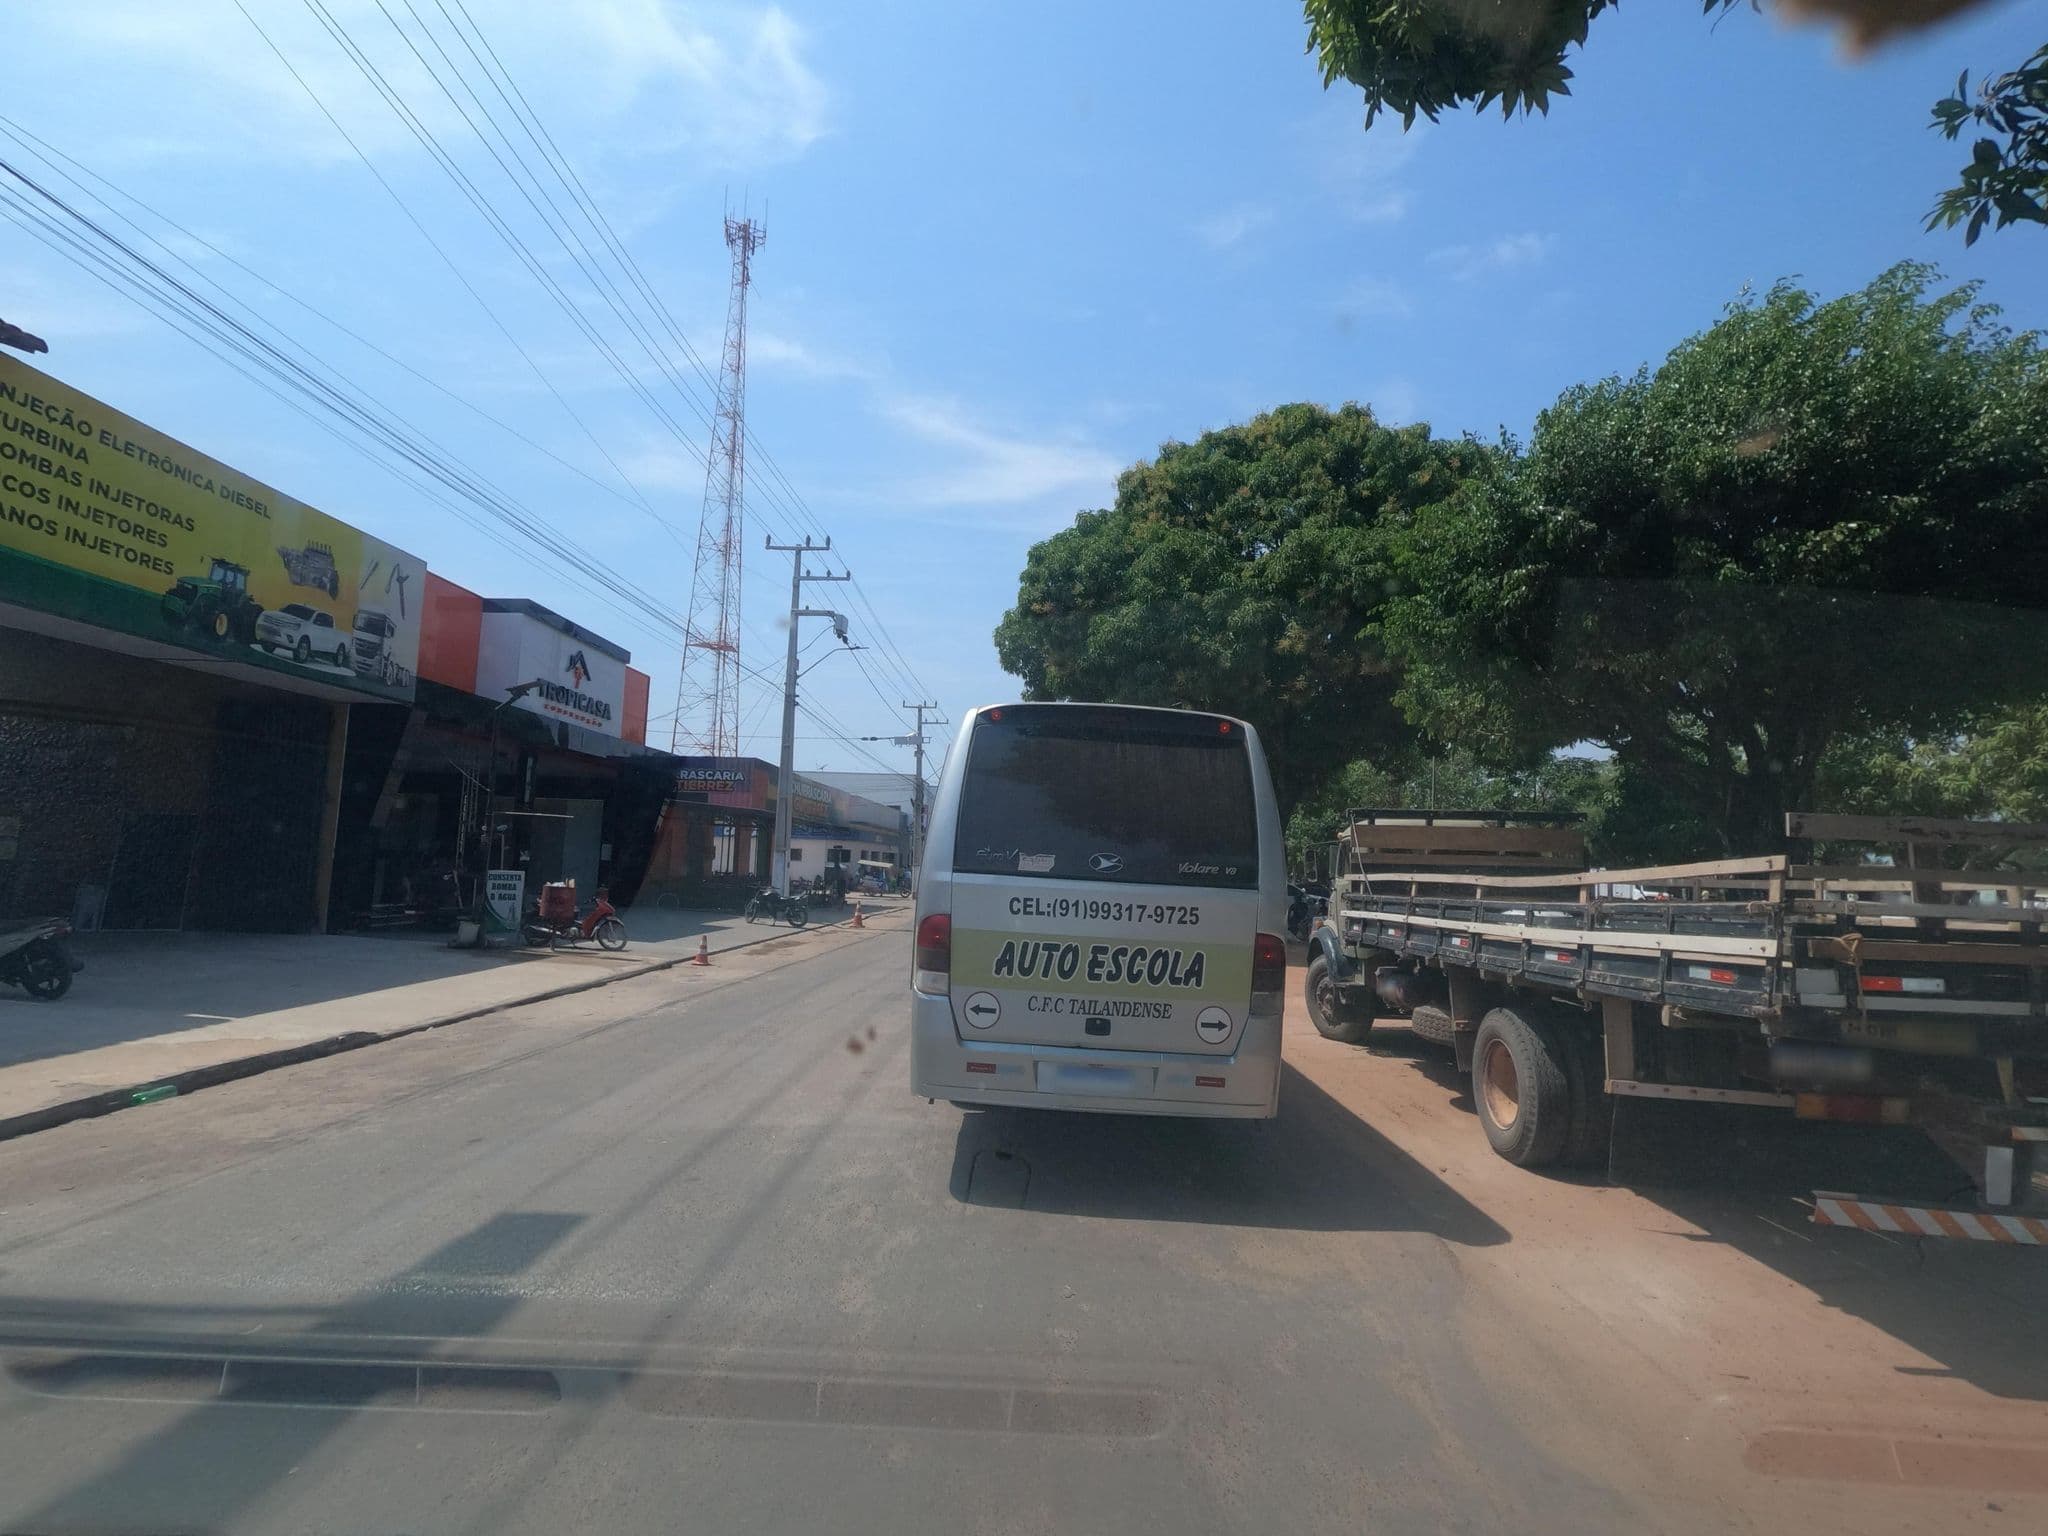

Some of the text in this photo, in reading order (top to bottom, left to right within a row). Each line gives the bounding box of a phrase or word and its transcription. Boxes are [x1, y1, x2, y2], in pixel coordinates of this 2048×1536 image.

[98, 428, 216, 493] ELETRÔNICA
[219, 484, 272, 520] DIESEL
[57, 494, 168, 548] INJETORES
[88, 477, 196, 534] INJETORAS
[64, 525, 174, 577] INJETORES
[1177, 862, 1220, 875] Volare
[1008, 896, 1201, 926] CEL:(91)99317-9725
[994, 941, 1206, 989] AUTO ESCOLA
[1027, 996, 1173, 1021] C.F.C TAILANDENSE
